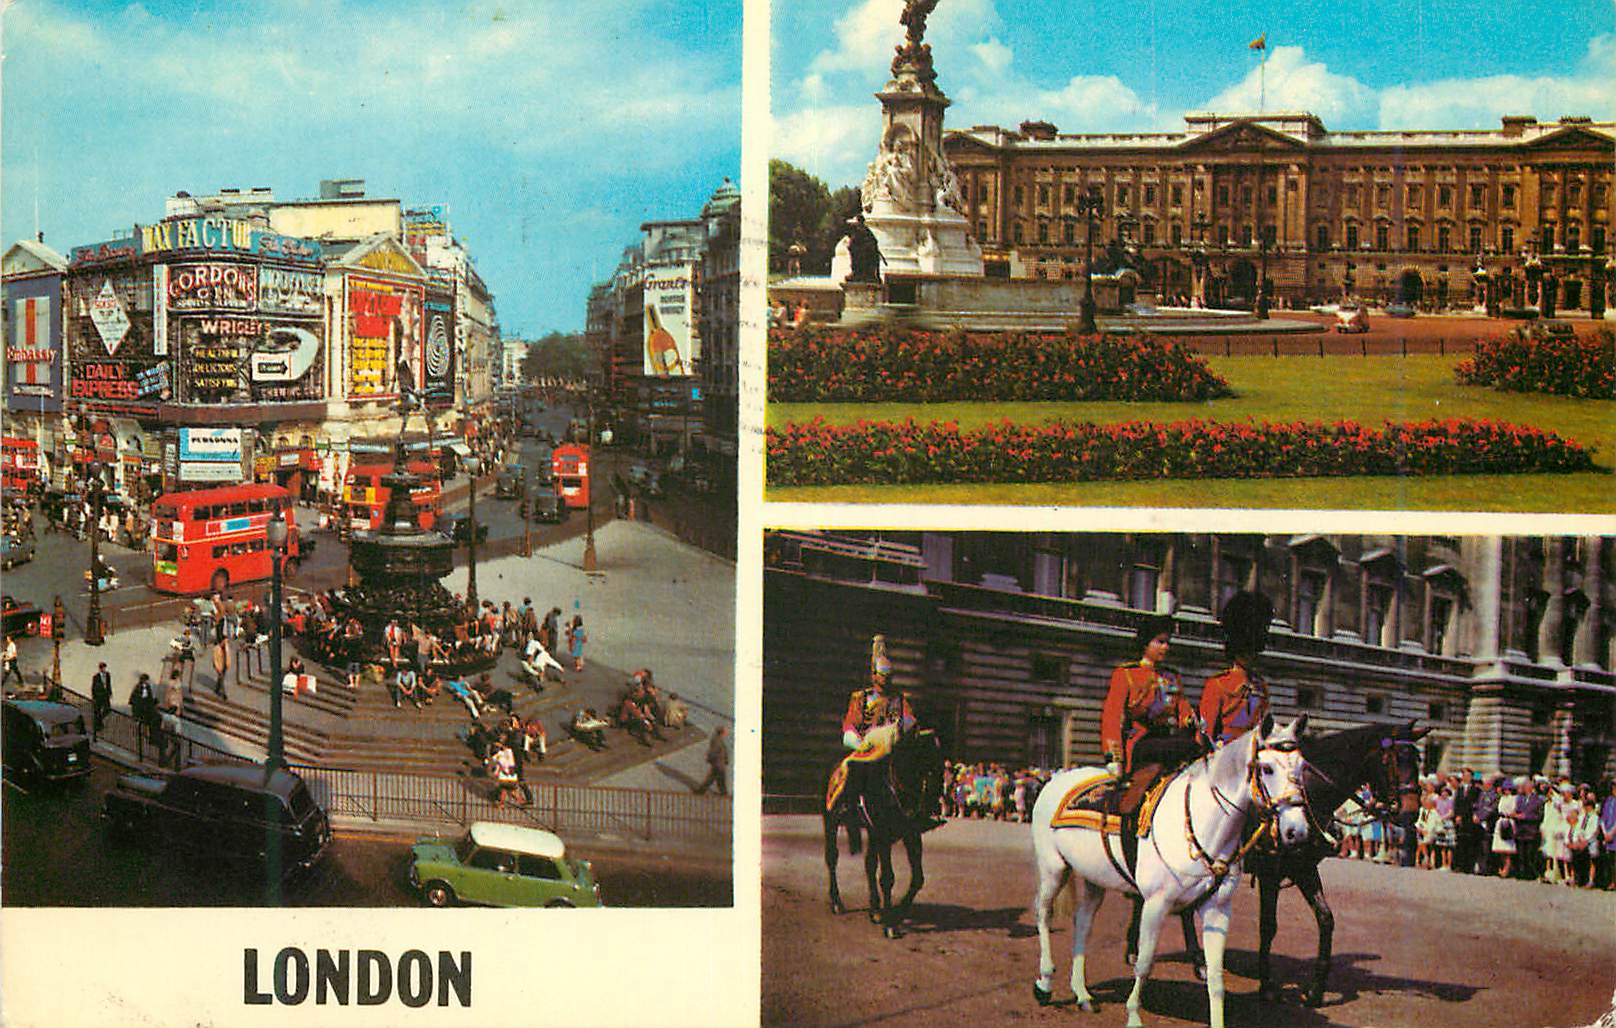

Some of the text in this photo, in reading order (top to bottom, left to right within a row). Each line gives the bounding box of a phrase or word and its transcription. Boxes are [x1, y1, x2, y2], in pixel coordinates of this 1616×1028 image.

[142, 222, 172, 252] MAX
[85, 363, 125, 380] DAILY
[72, 378, 140, 400] EXPRESS
